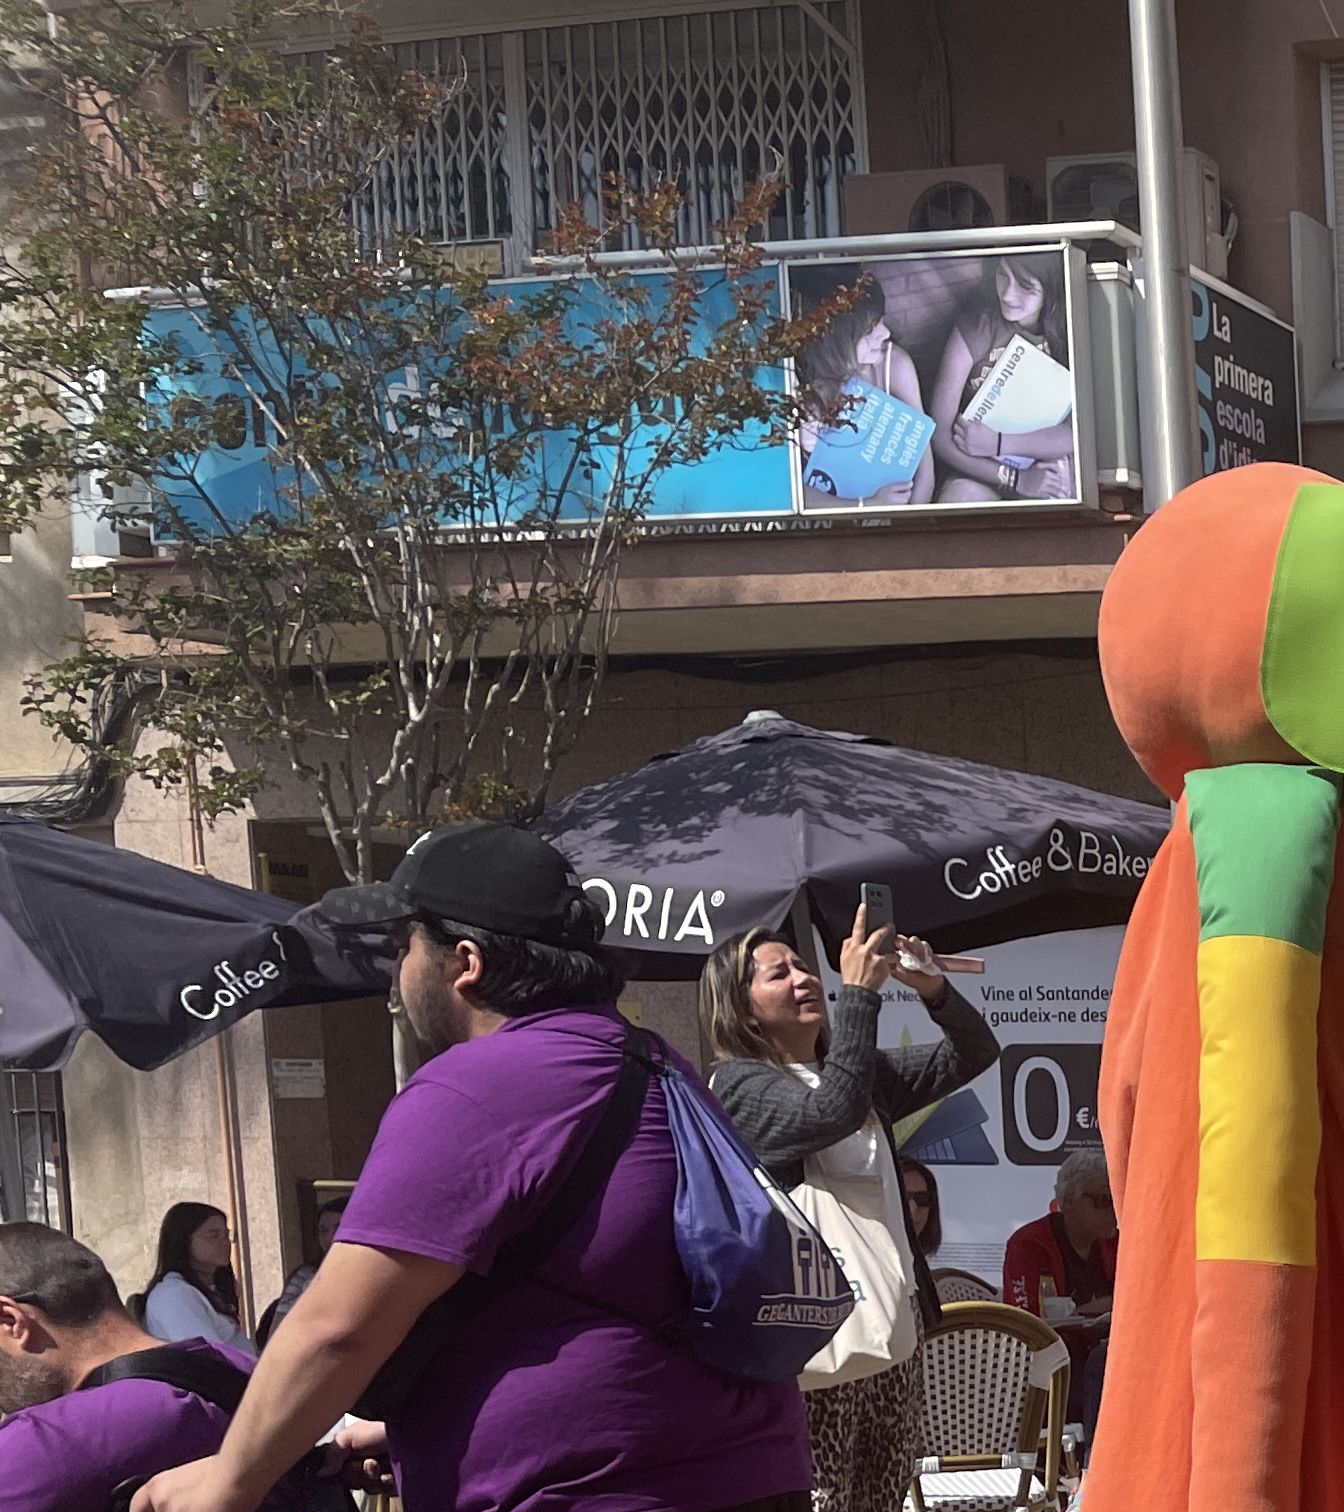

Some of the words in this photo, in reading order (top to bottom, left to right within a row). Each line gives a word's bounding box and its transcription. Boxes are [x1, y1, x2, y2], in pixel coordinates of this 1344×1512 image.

[1212, 302, 1231, 343] La
[968, 345, 1026, 424] centredellen
[1214, 354, 1274, 407] primera
[860, 401, 895, 464] alemany
[1216, 399, 1266, 445] escola
[944, 845, 1042, 900] Coffee
[1047, 828, 1074, 871] &
[1078, 831, 1157, 878] Baker
[180, 959, 280, 1021] Coffee
[980, 985, 1015, 1001] Vine
[1018, 985, 1033, 1001] al
[990, 1007, 1077, 1027] gaudeix-ne
[1014, 1056, 1070, 1152] 0
